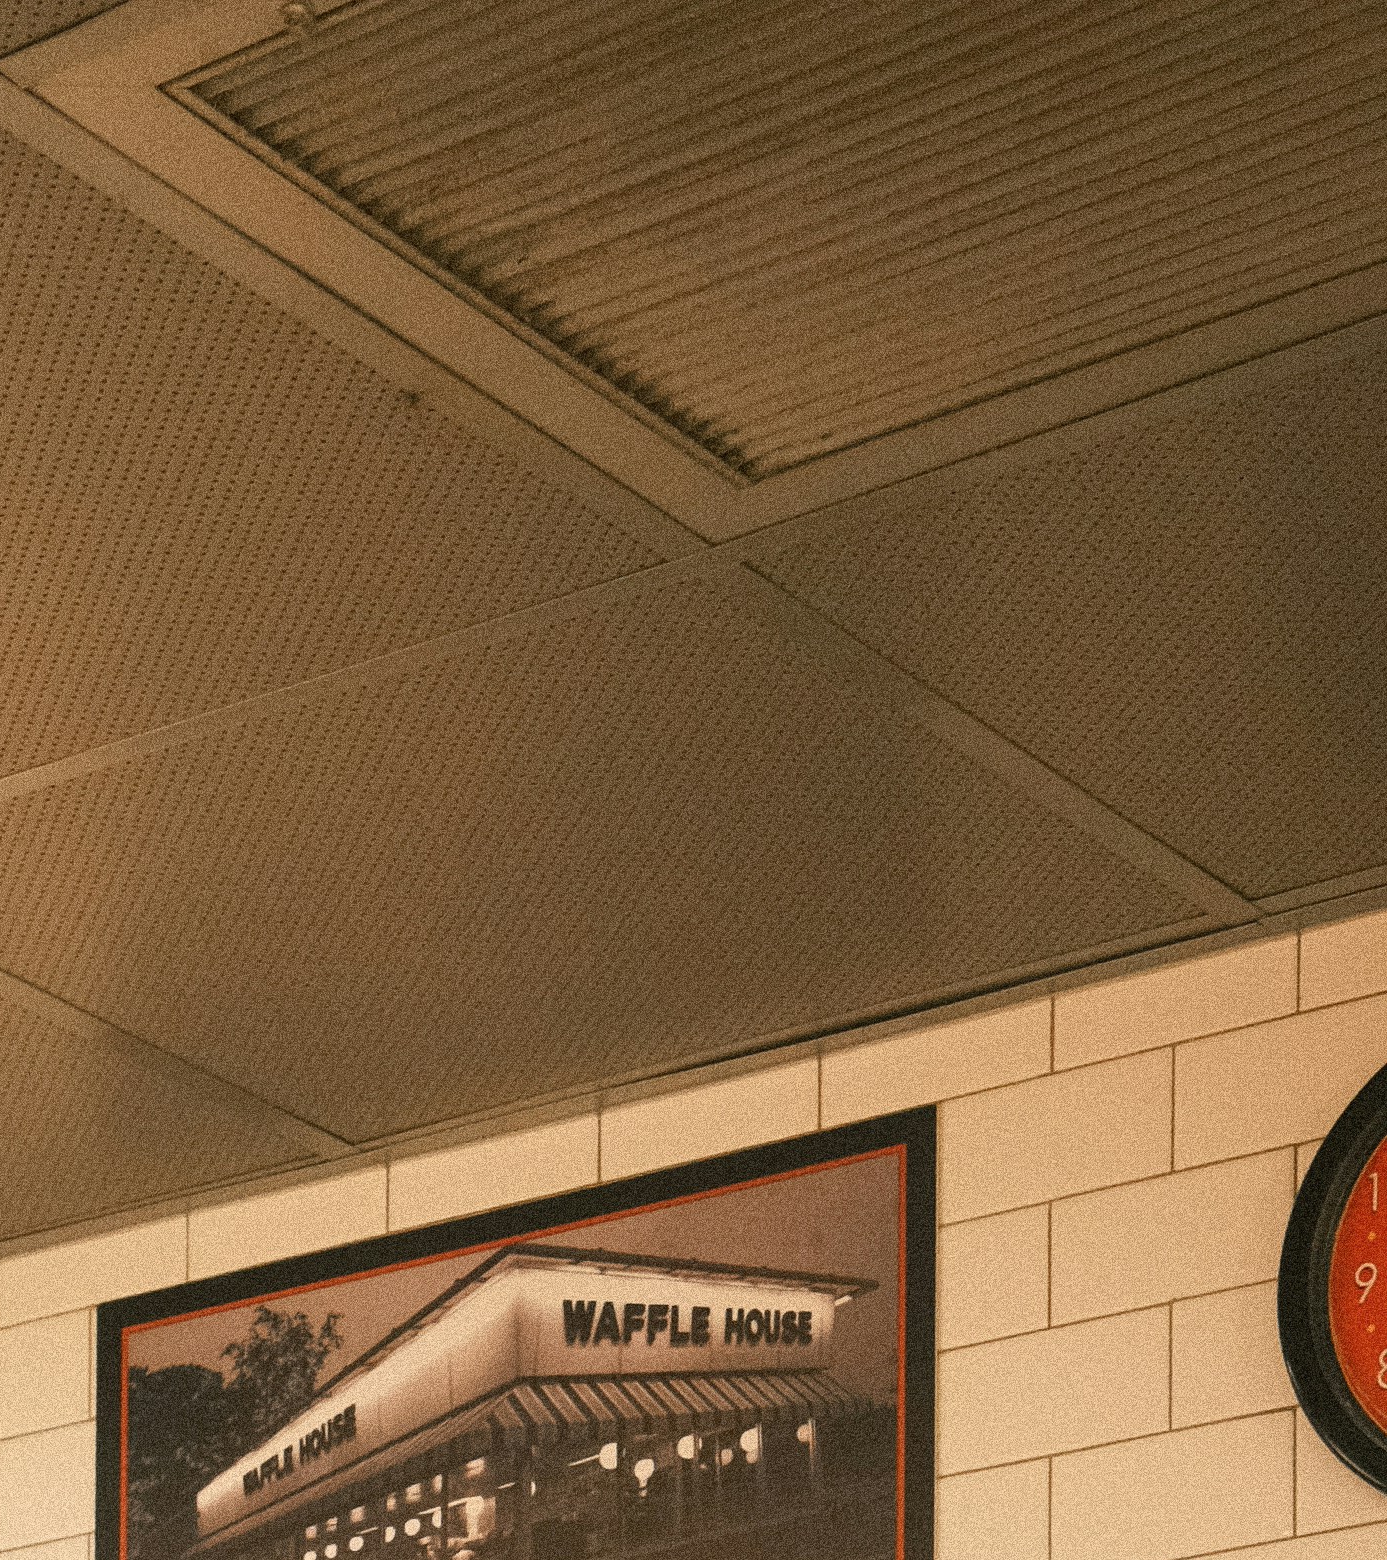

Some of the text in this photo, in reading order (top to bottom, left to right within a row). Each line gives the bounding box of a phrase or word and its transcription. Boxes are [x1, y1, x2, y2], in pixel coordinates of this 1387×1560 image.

[1354, 1262, 1378, 1304] 9
[560, 1298, 815, 1347] WAFFLE HOUSE
[242, 1404, 358, 1495] WAFFLE HOUSE
